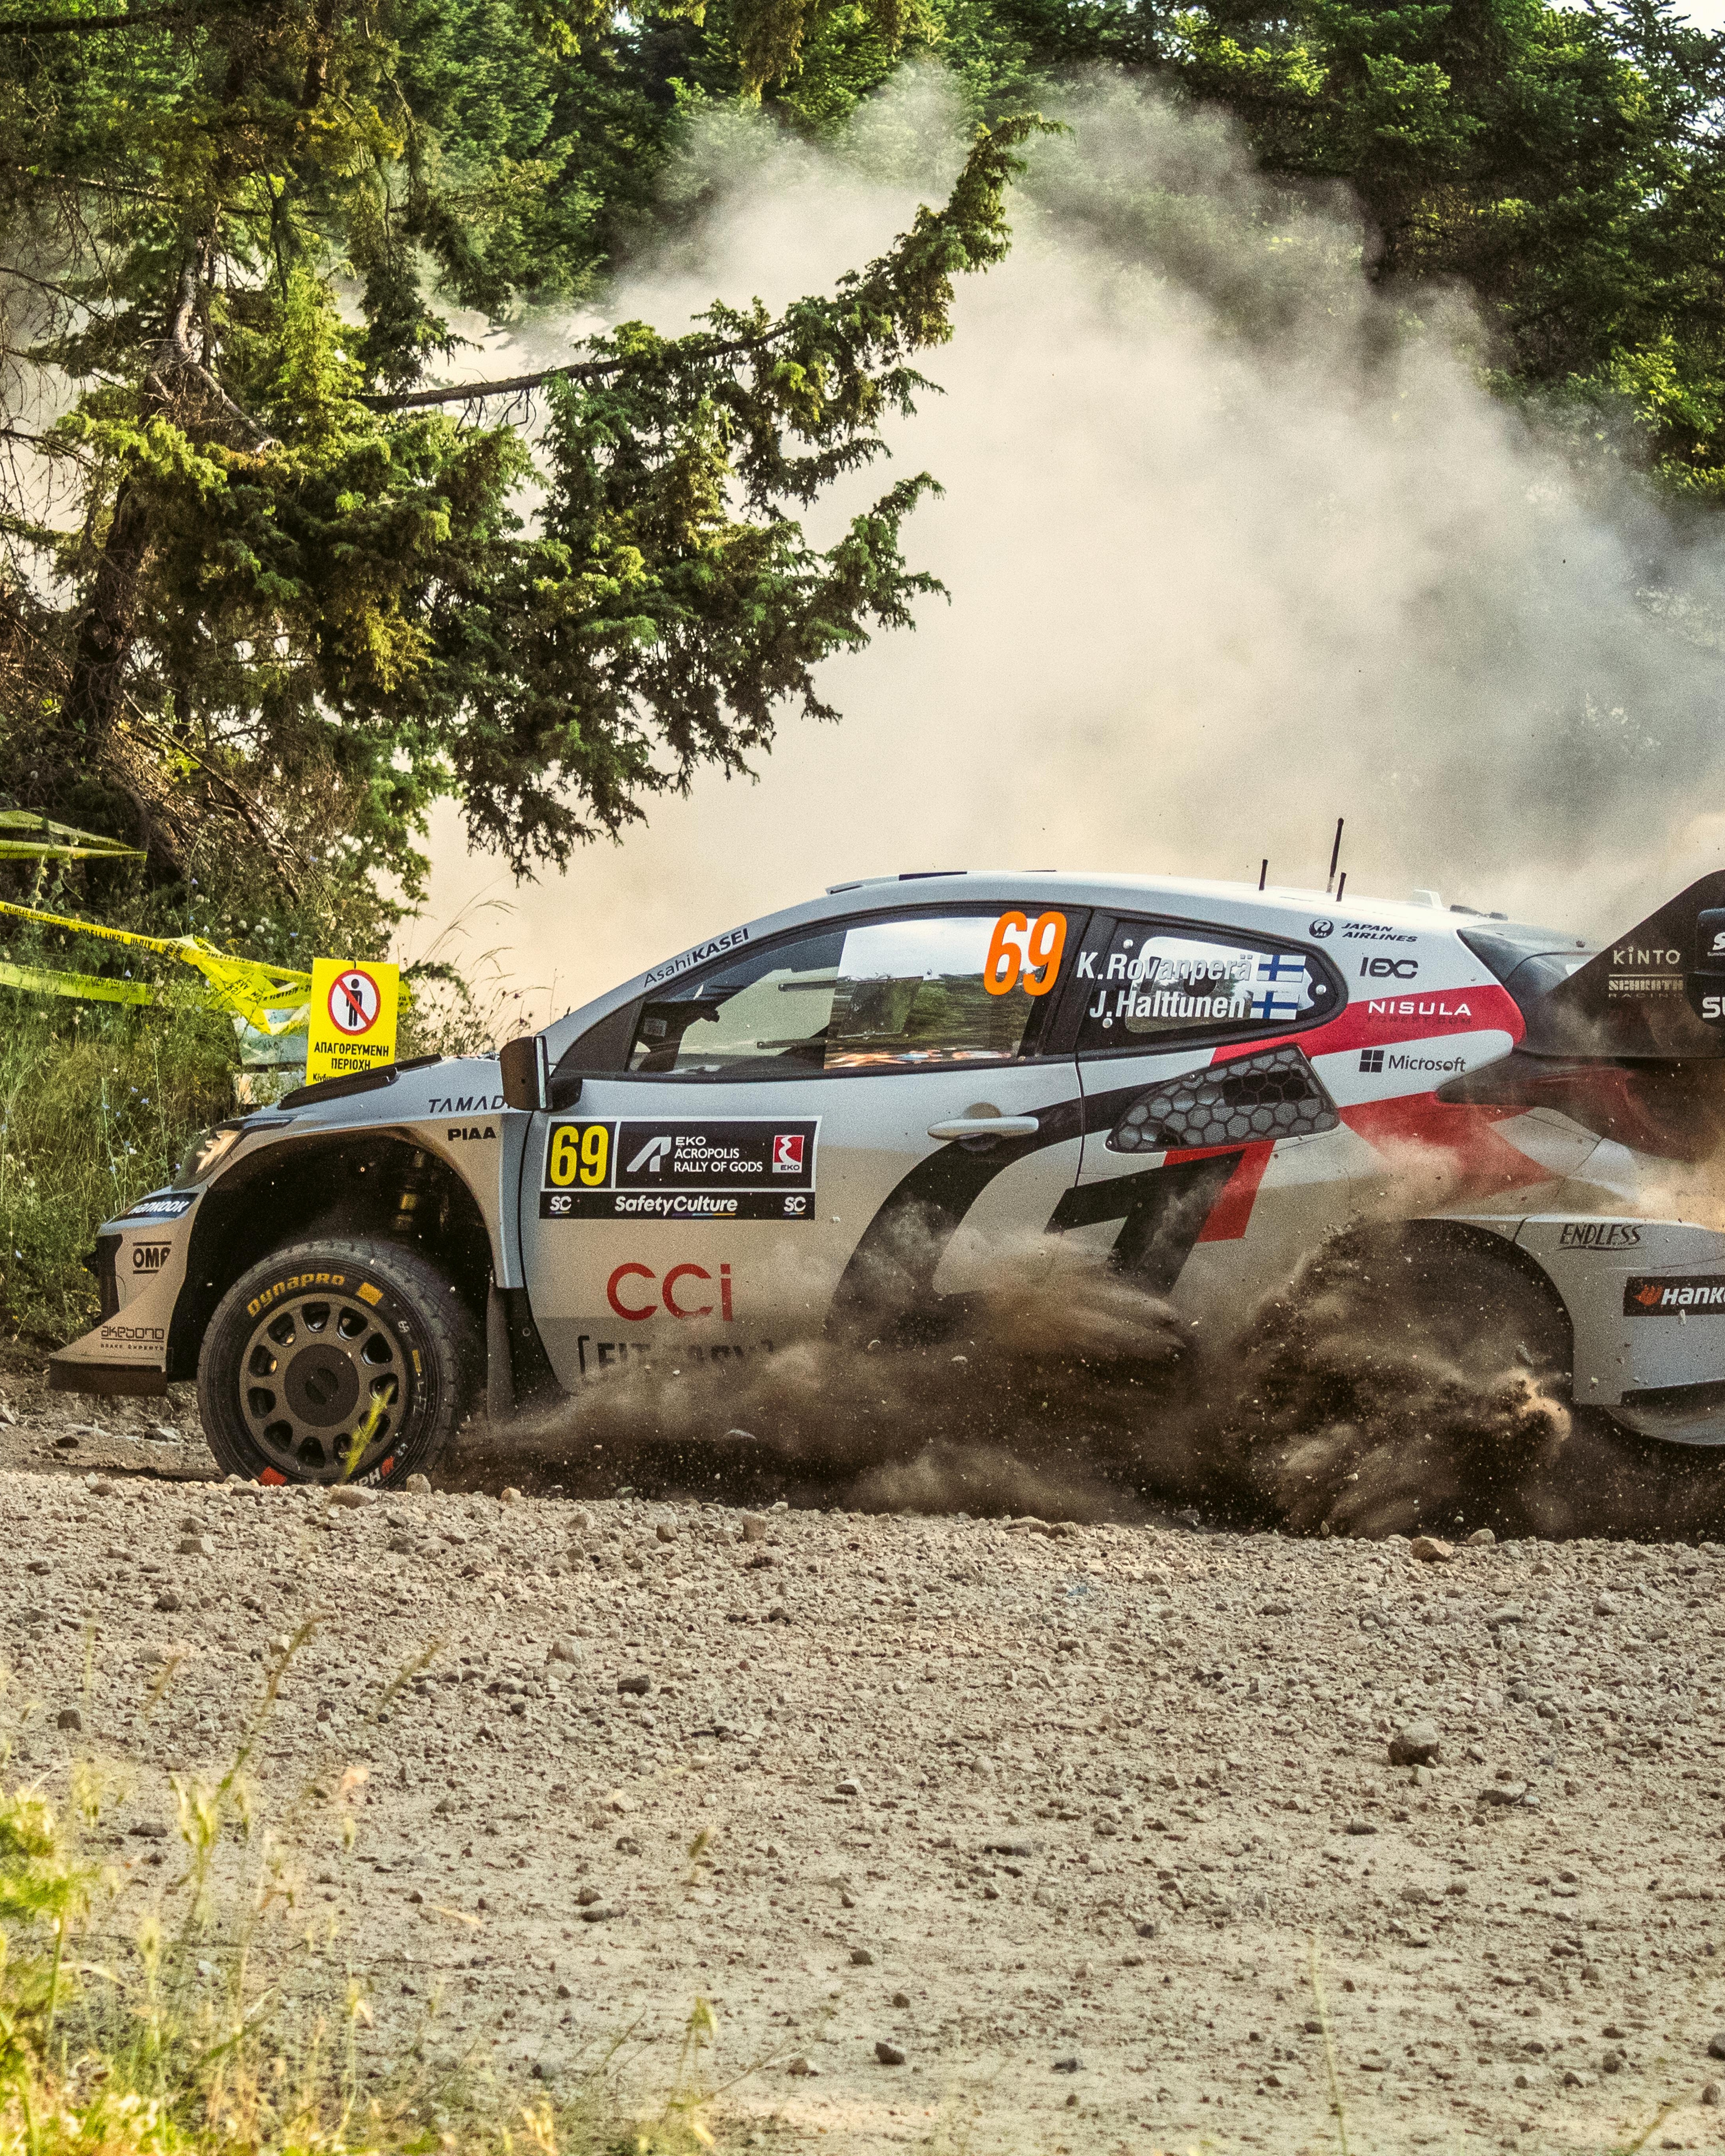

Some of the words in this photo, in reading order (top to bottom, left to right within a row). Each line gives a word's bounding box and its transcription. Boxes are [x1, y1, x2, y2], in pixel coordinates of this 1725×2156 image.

[1341, 923, 1393, 932] JAPAN
[1342, 932, 1418, 942] AIRLINES
[984, 911, 1067, 996] 69
[1368, 1001, 1471, 1016] NISULA
[314, 1041, 389, 1057] ΑΠΑΓΟΡΕΥΜΕΝΗ
[331, 1058, 371, 1071] ΠΕΡΙΟΧΗ
[1388, 1055, 1466, 1072] Microsoft
[447, 1126, 497, 1141] PIAA
[676, 1136, 707, 1146] EKO
[550, 1125, 609, 1186] 69
[674, 1147, 740, 1159] ACROPOLIS
[674, 1161, 709, 1172] RALLY
[711, 1161, 727, 1172] OF
[729, 1161, 763, 1173] GODS
[550, 1195, 572, 1212] SC
[615, 1195, 738, 1216] SafetyCulture
[784, 1196, 806, 1212] SC
[1560, 1223, 1644, 1245] ENDLESS
[133, 1247, 171, 1268] OMP
[101, 1326, 165, 1340] akebono
